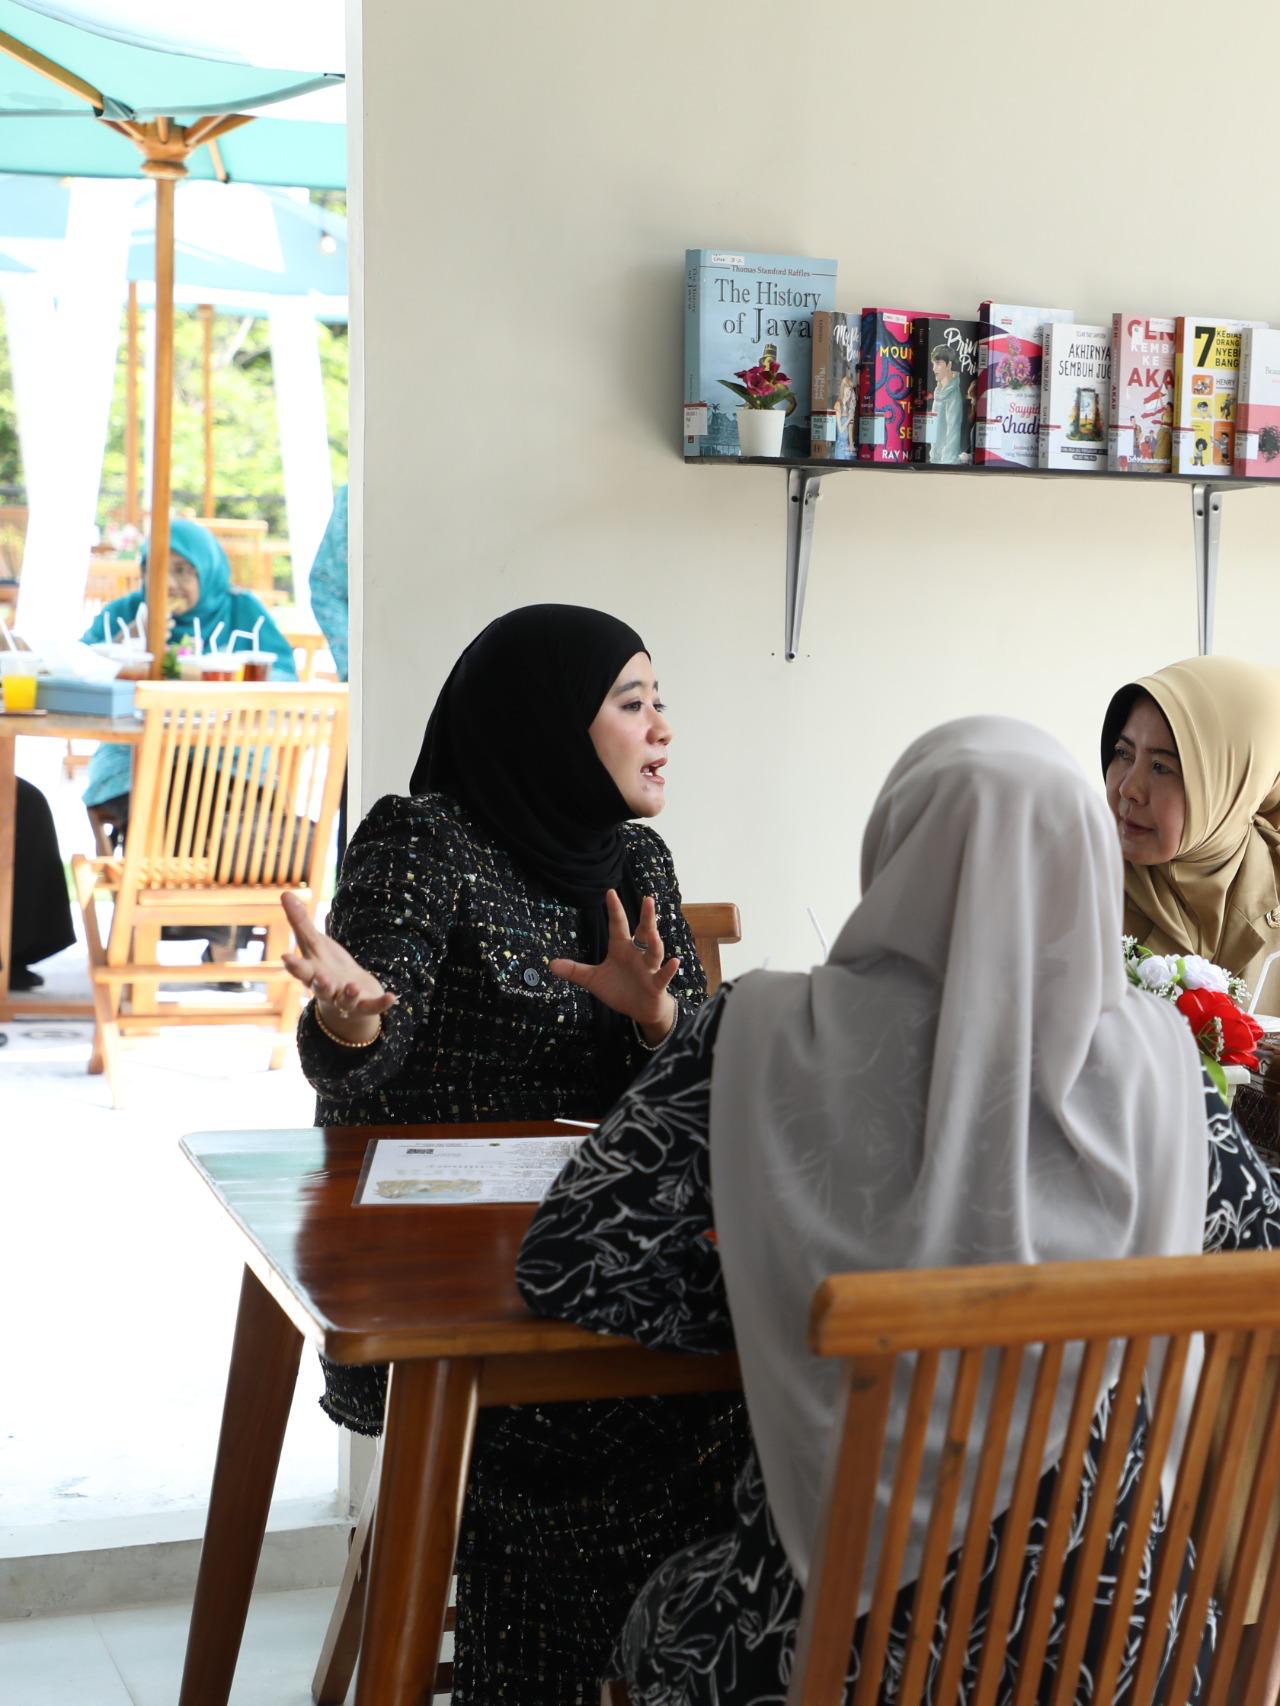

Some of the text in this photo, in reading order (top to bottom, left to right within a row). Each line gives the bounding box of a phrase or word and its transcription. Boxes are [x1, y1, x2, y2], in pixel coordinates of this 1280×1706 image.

[714, 277, 751, 304] The
[756, 281, 822, 312] History
[722, 312, 747, 335] of
[751, 307, 812, 344] Java
[880, 346, 912, 360] MOU
[1068, 343, 1111, 361] AKHIRNYA
[1195, 326, 1216, 367] 7
[1058, 360, 1094, 378] SEMBUH
[882, 449, 900, 460] RAY
